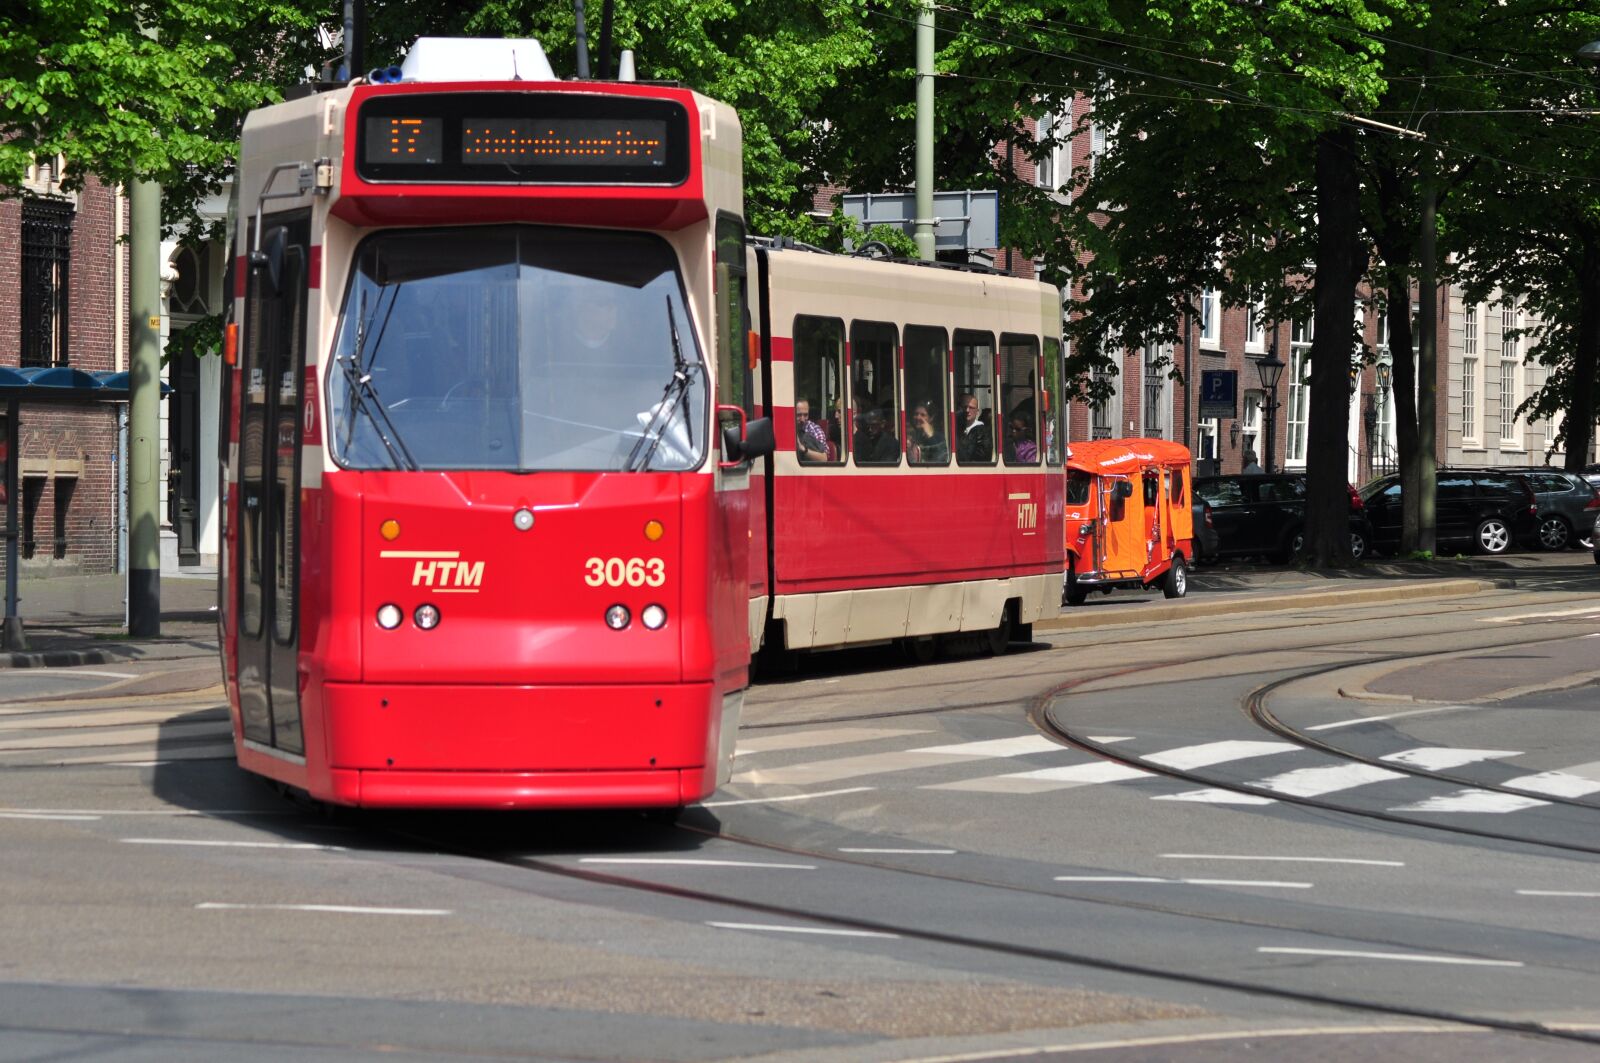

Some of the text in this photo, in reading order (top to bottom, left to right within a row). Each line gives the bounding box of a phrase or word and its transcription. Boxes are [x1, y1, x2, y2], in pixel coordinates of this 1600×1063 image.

[391, 119, 422, 153] 17
[1212, 378, 1222, 393] P
[1018, 503, 1037, 528] HTM
[411, 560, 486, 587] HTM
[584, 557, 666, 588] 3063
